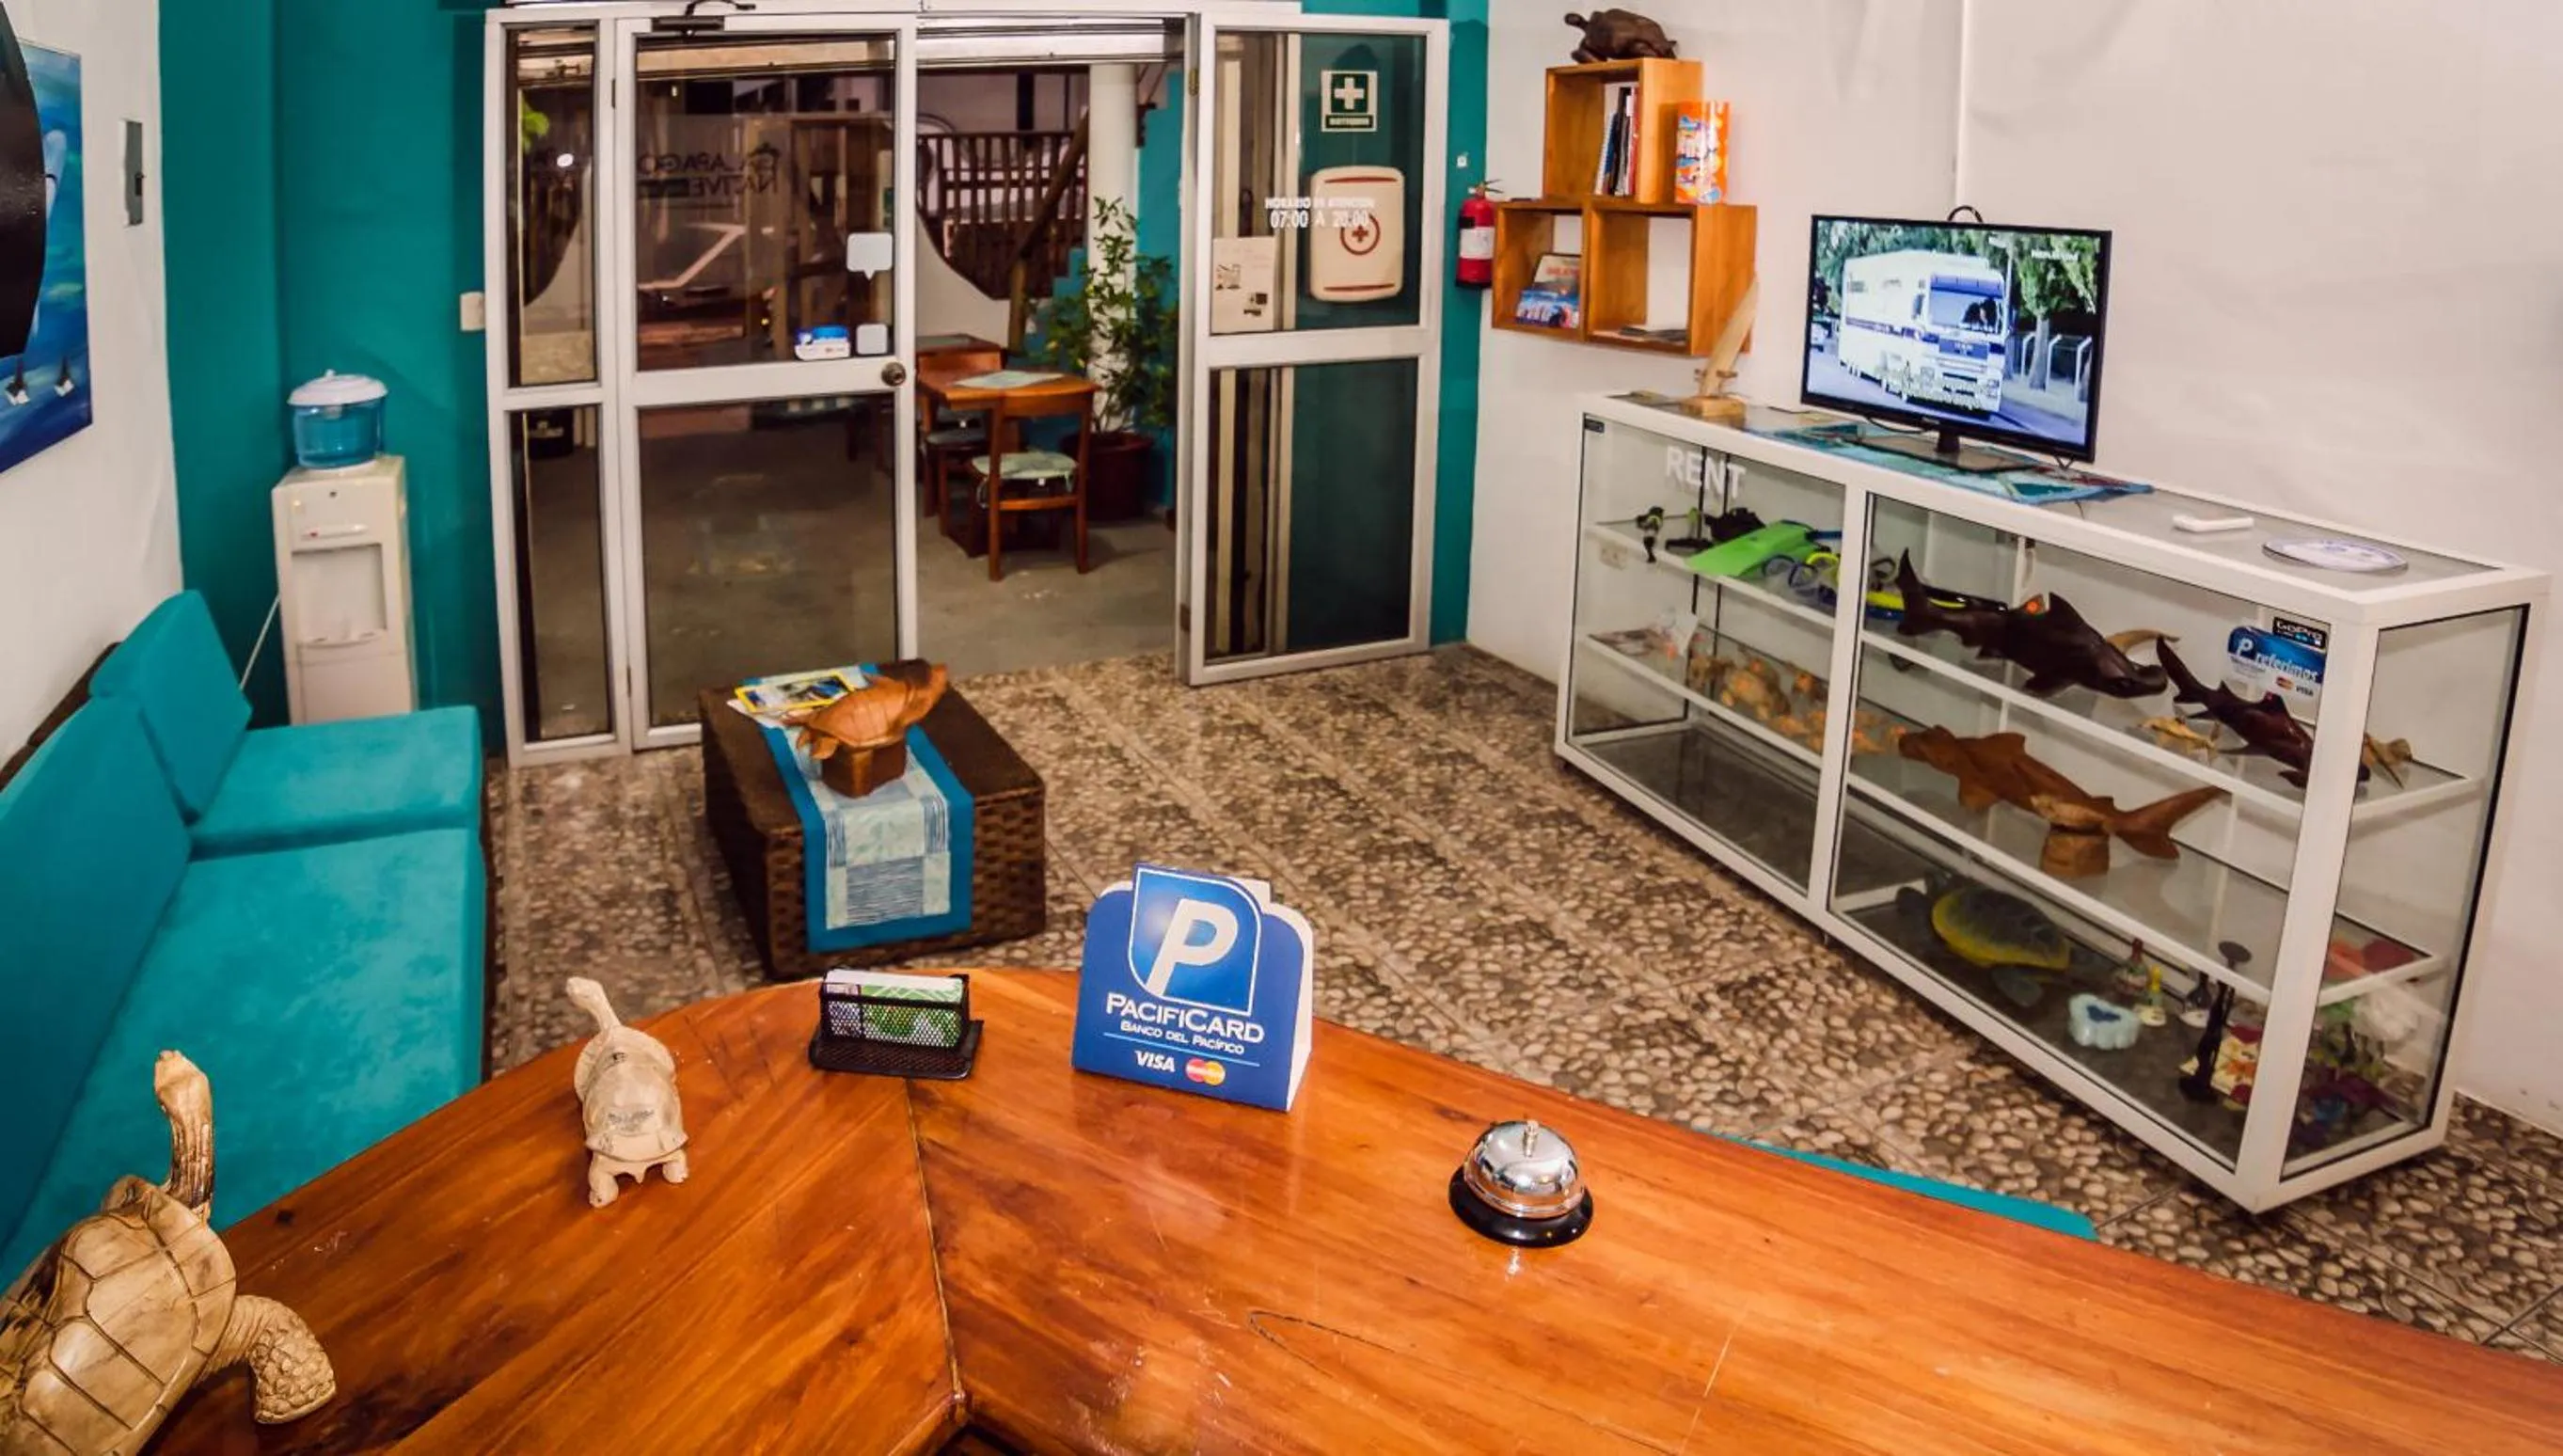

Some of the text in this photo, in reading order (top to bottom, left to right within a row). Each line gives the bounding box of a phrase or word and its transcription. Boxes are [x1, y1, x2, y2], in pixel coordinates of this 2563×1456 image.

[1270, 210, 1309, 228] 07:00
[1666, 445, 1747, 500] RENT
[1146, 897, 1239, 997] P
[1134, 1050, 1176, 1073] VISA
